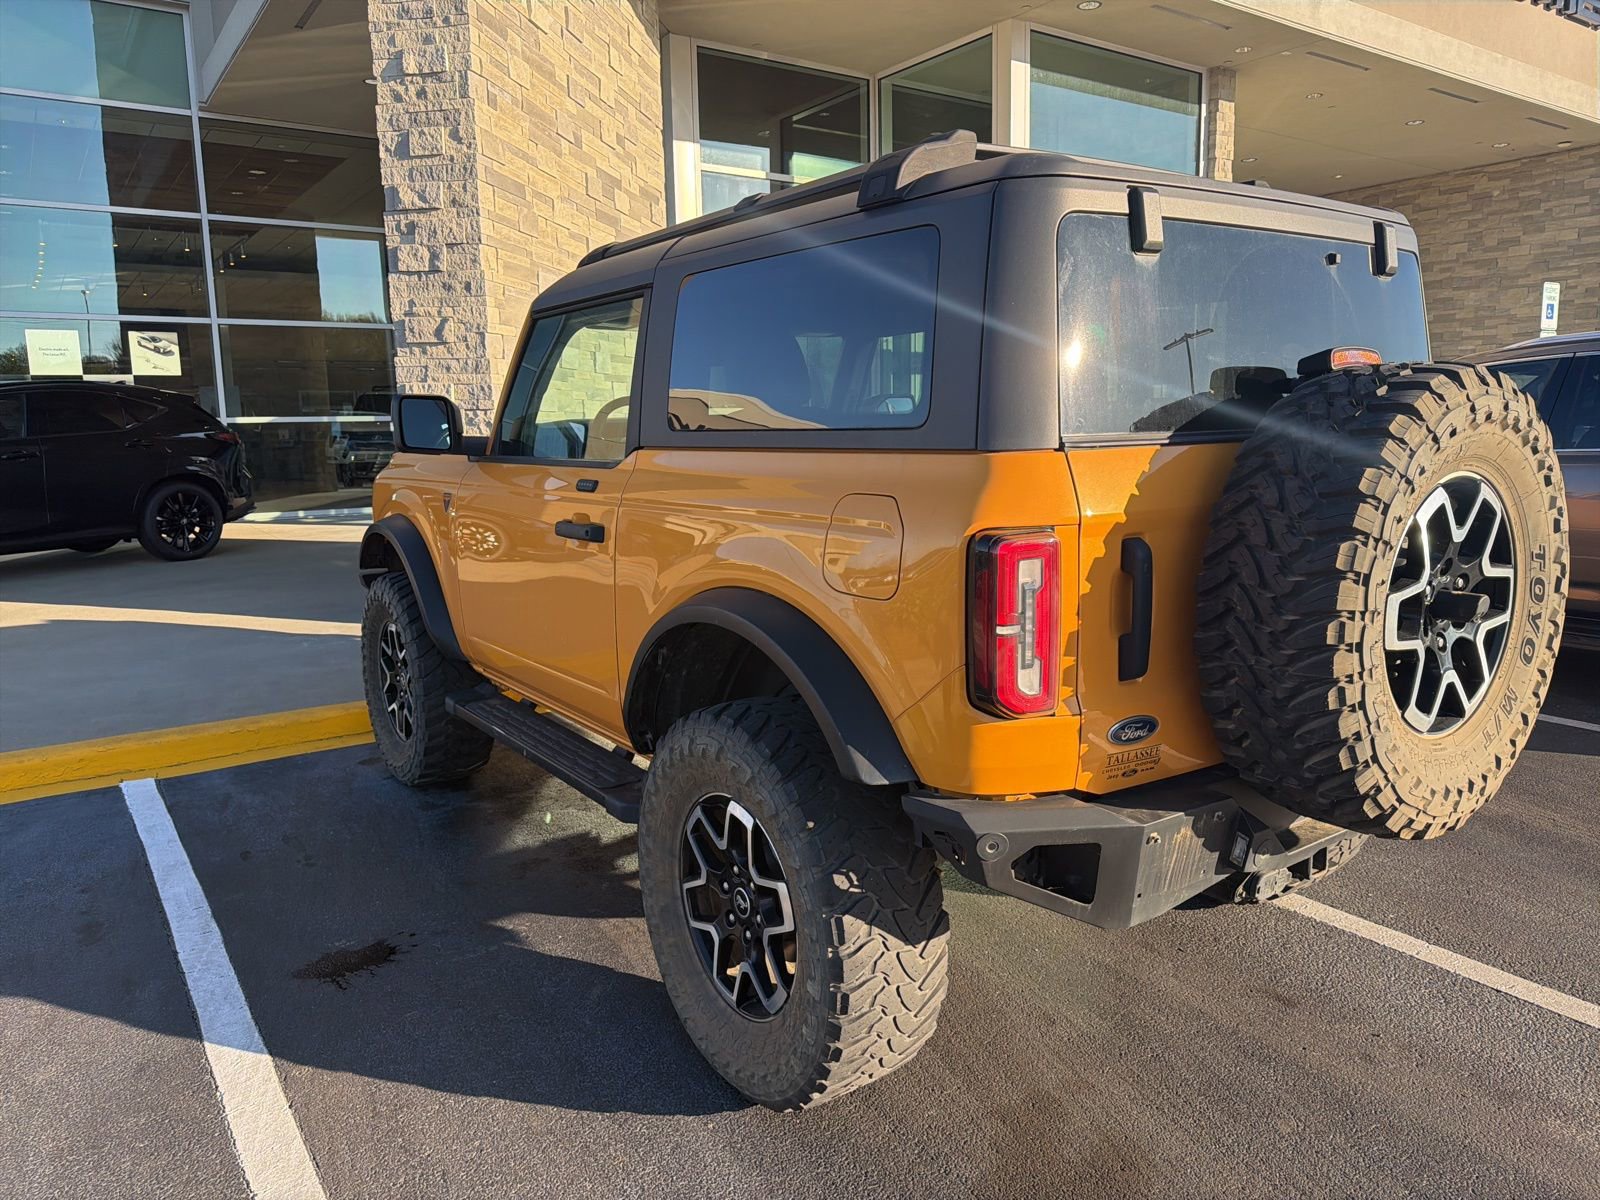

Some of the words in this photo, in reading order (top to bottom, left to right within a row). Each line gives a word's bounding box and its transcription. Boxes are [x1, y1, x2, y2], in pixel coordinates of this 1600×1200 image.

[1520, 543, 1546, 668] TOYO
[1121, 722, 1150, 740] Ford
[1481, 684, 1519, 751] M/T
[1106, 746, 1161, 766] TALLASSEE
